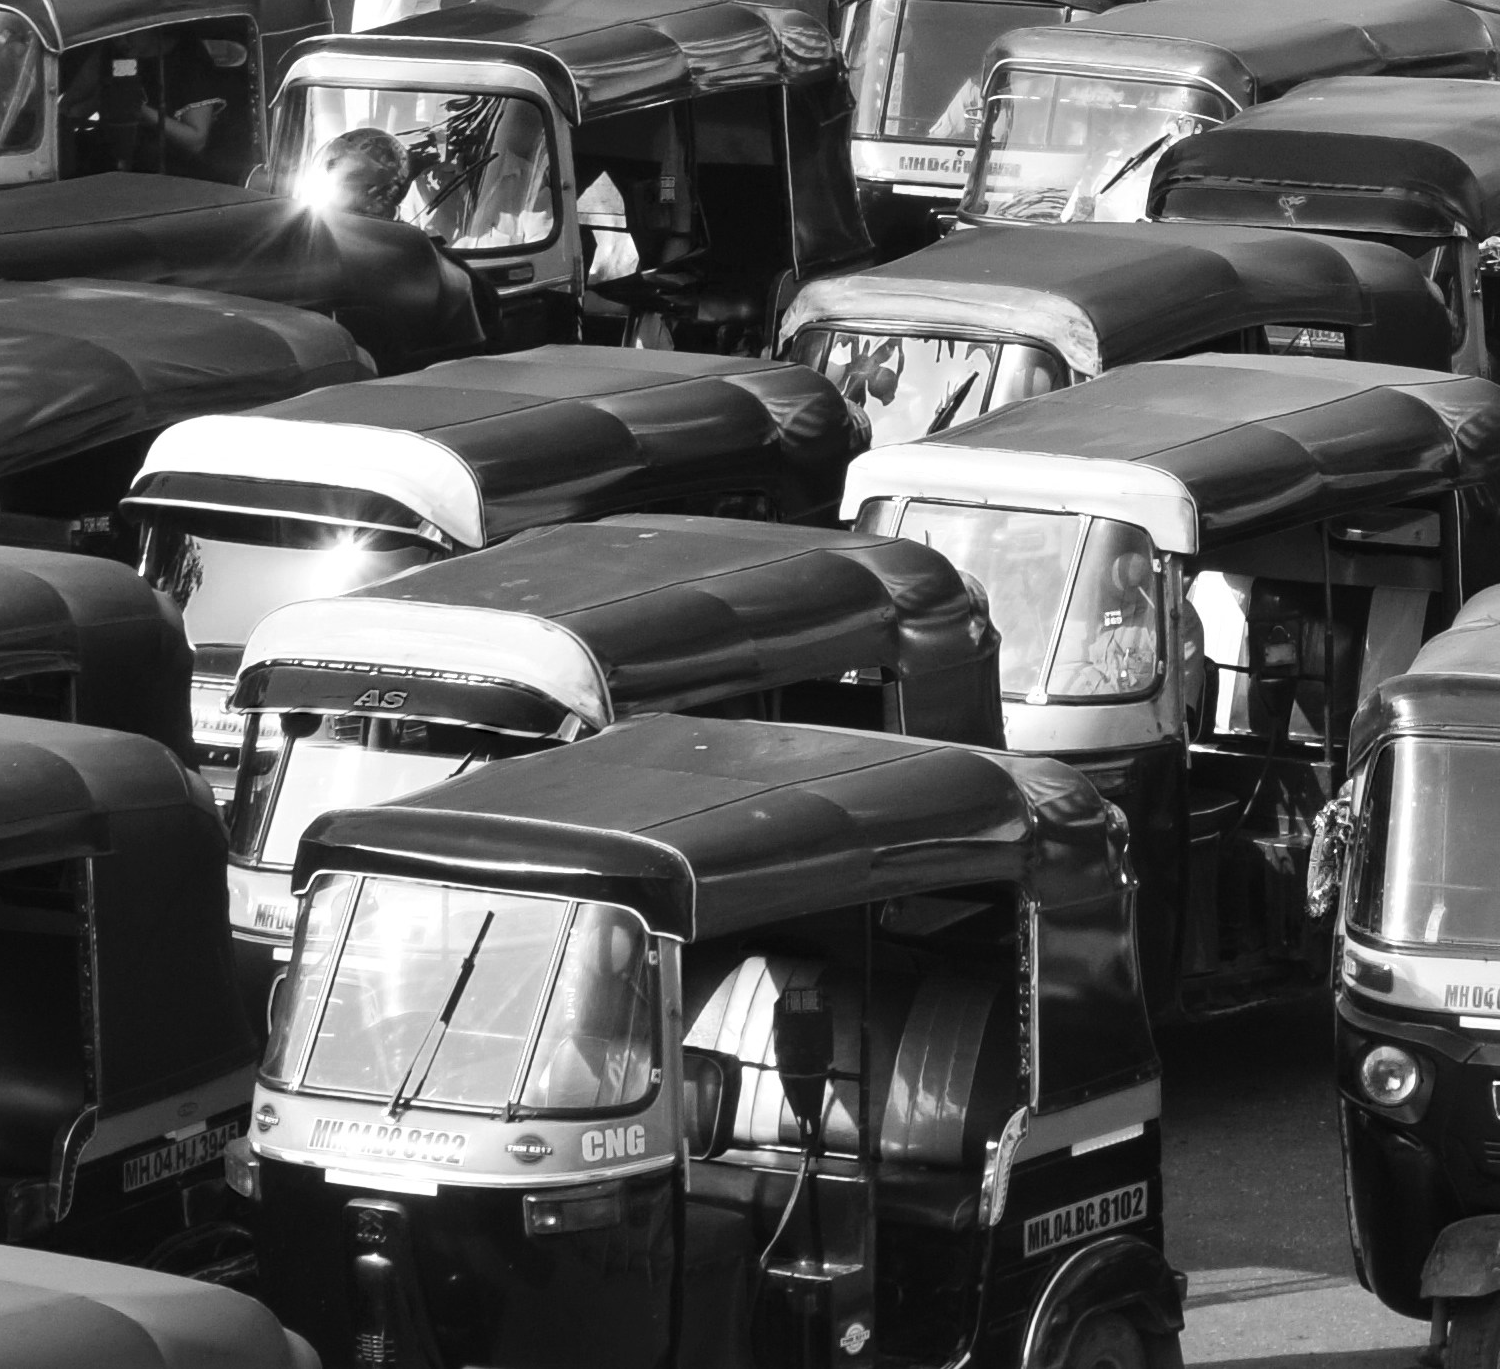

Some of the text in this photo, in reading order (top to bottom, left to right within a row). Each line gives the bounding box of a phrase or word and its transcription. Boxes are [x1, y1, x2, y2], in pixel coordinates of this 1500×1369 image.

[353, 689, 410, 709] AS
[581, 1125, 645, 1162] CNG
[1026, 1186, 1145, 1247] MH.04.BC.8102
